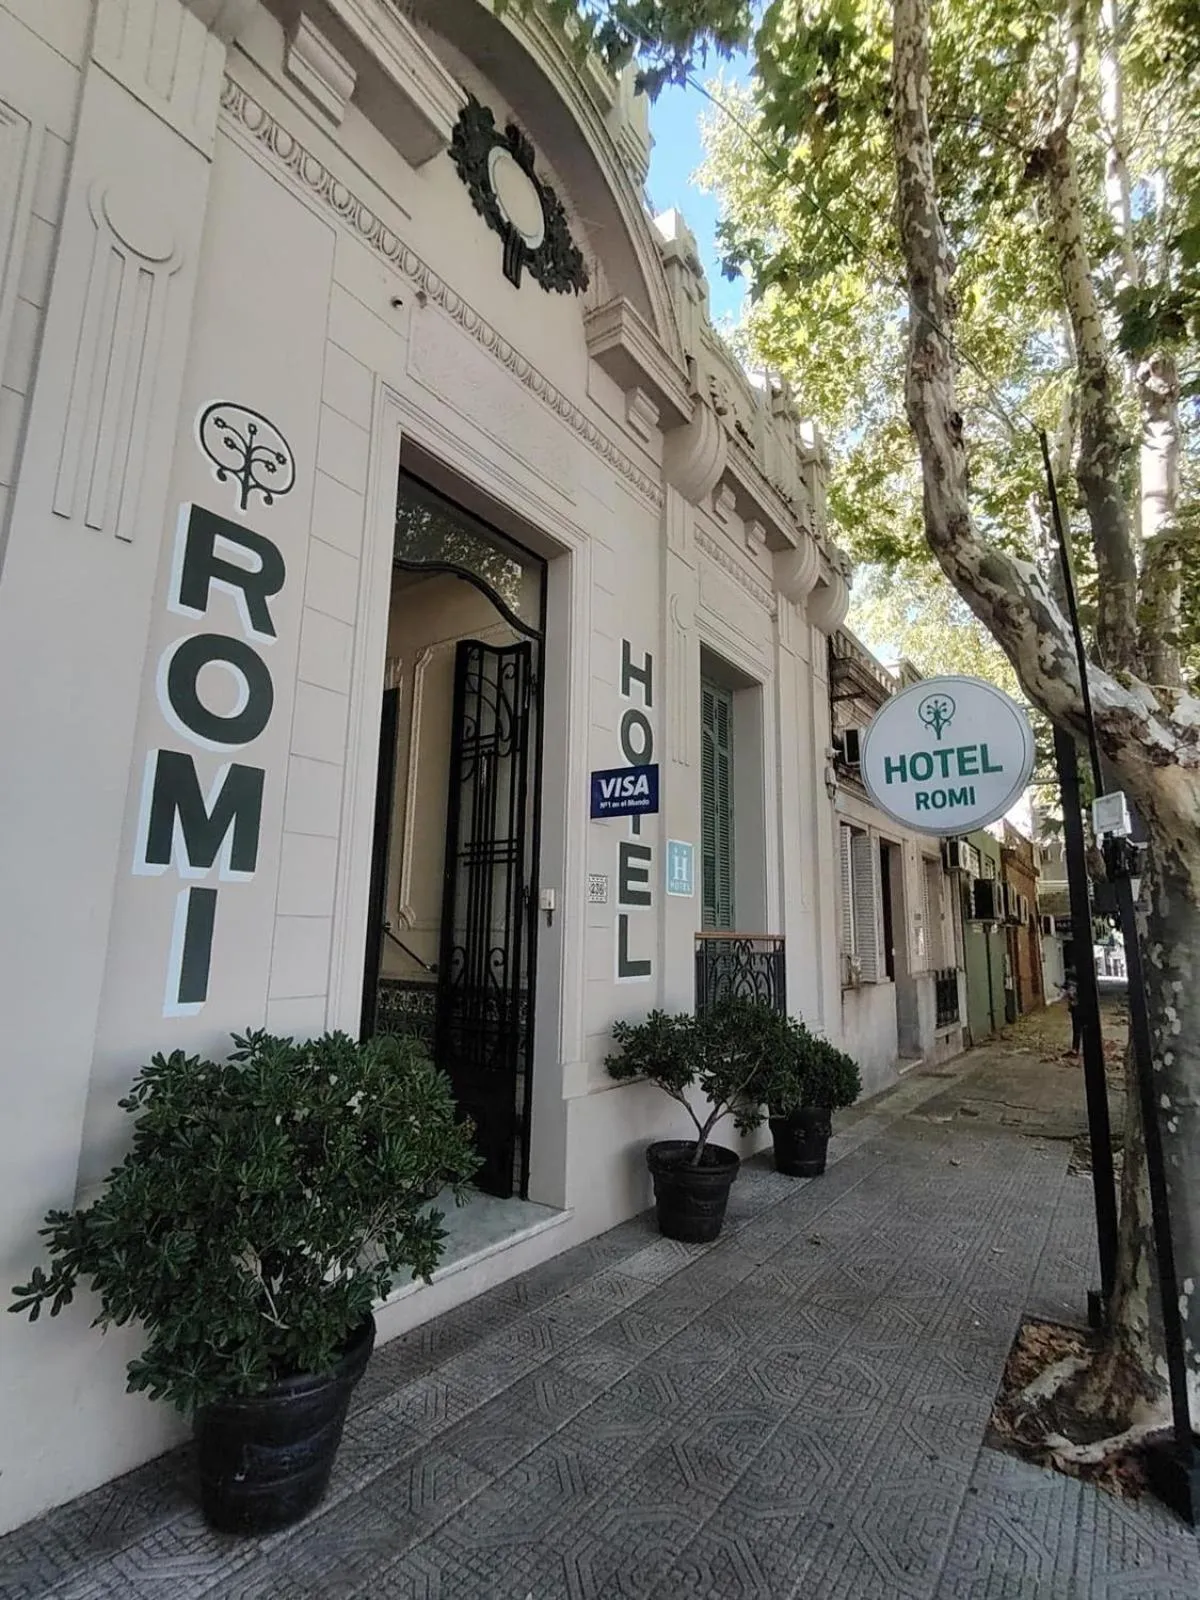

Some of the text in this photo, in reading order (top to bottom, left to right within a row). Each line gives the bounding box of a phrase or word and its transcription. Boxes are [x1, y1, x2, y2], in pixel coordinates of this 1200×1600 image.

[140, 502, 286, 1009] ROMI
[884, 743, 1003, 784] HOTEL
[598, 774, 650, 798] VISA
[915, 786, 976, 811] ROMI
